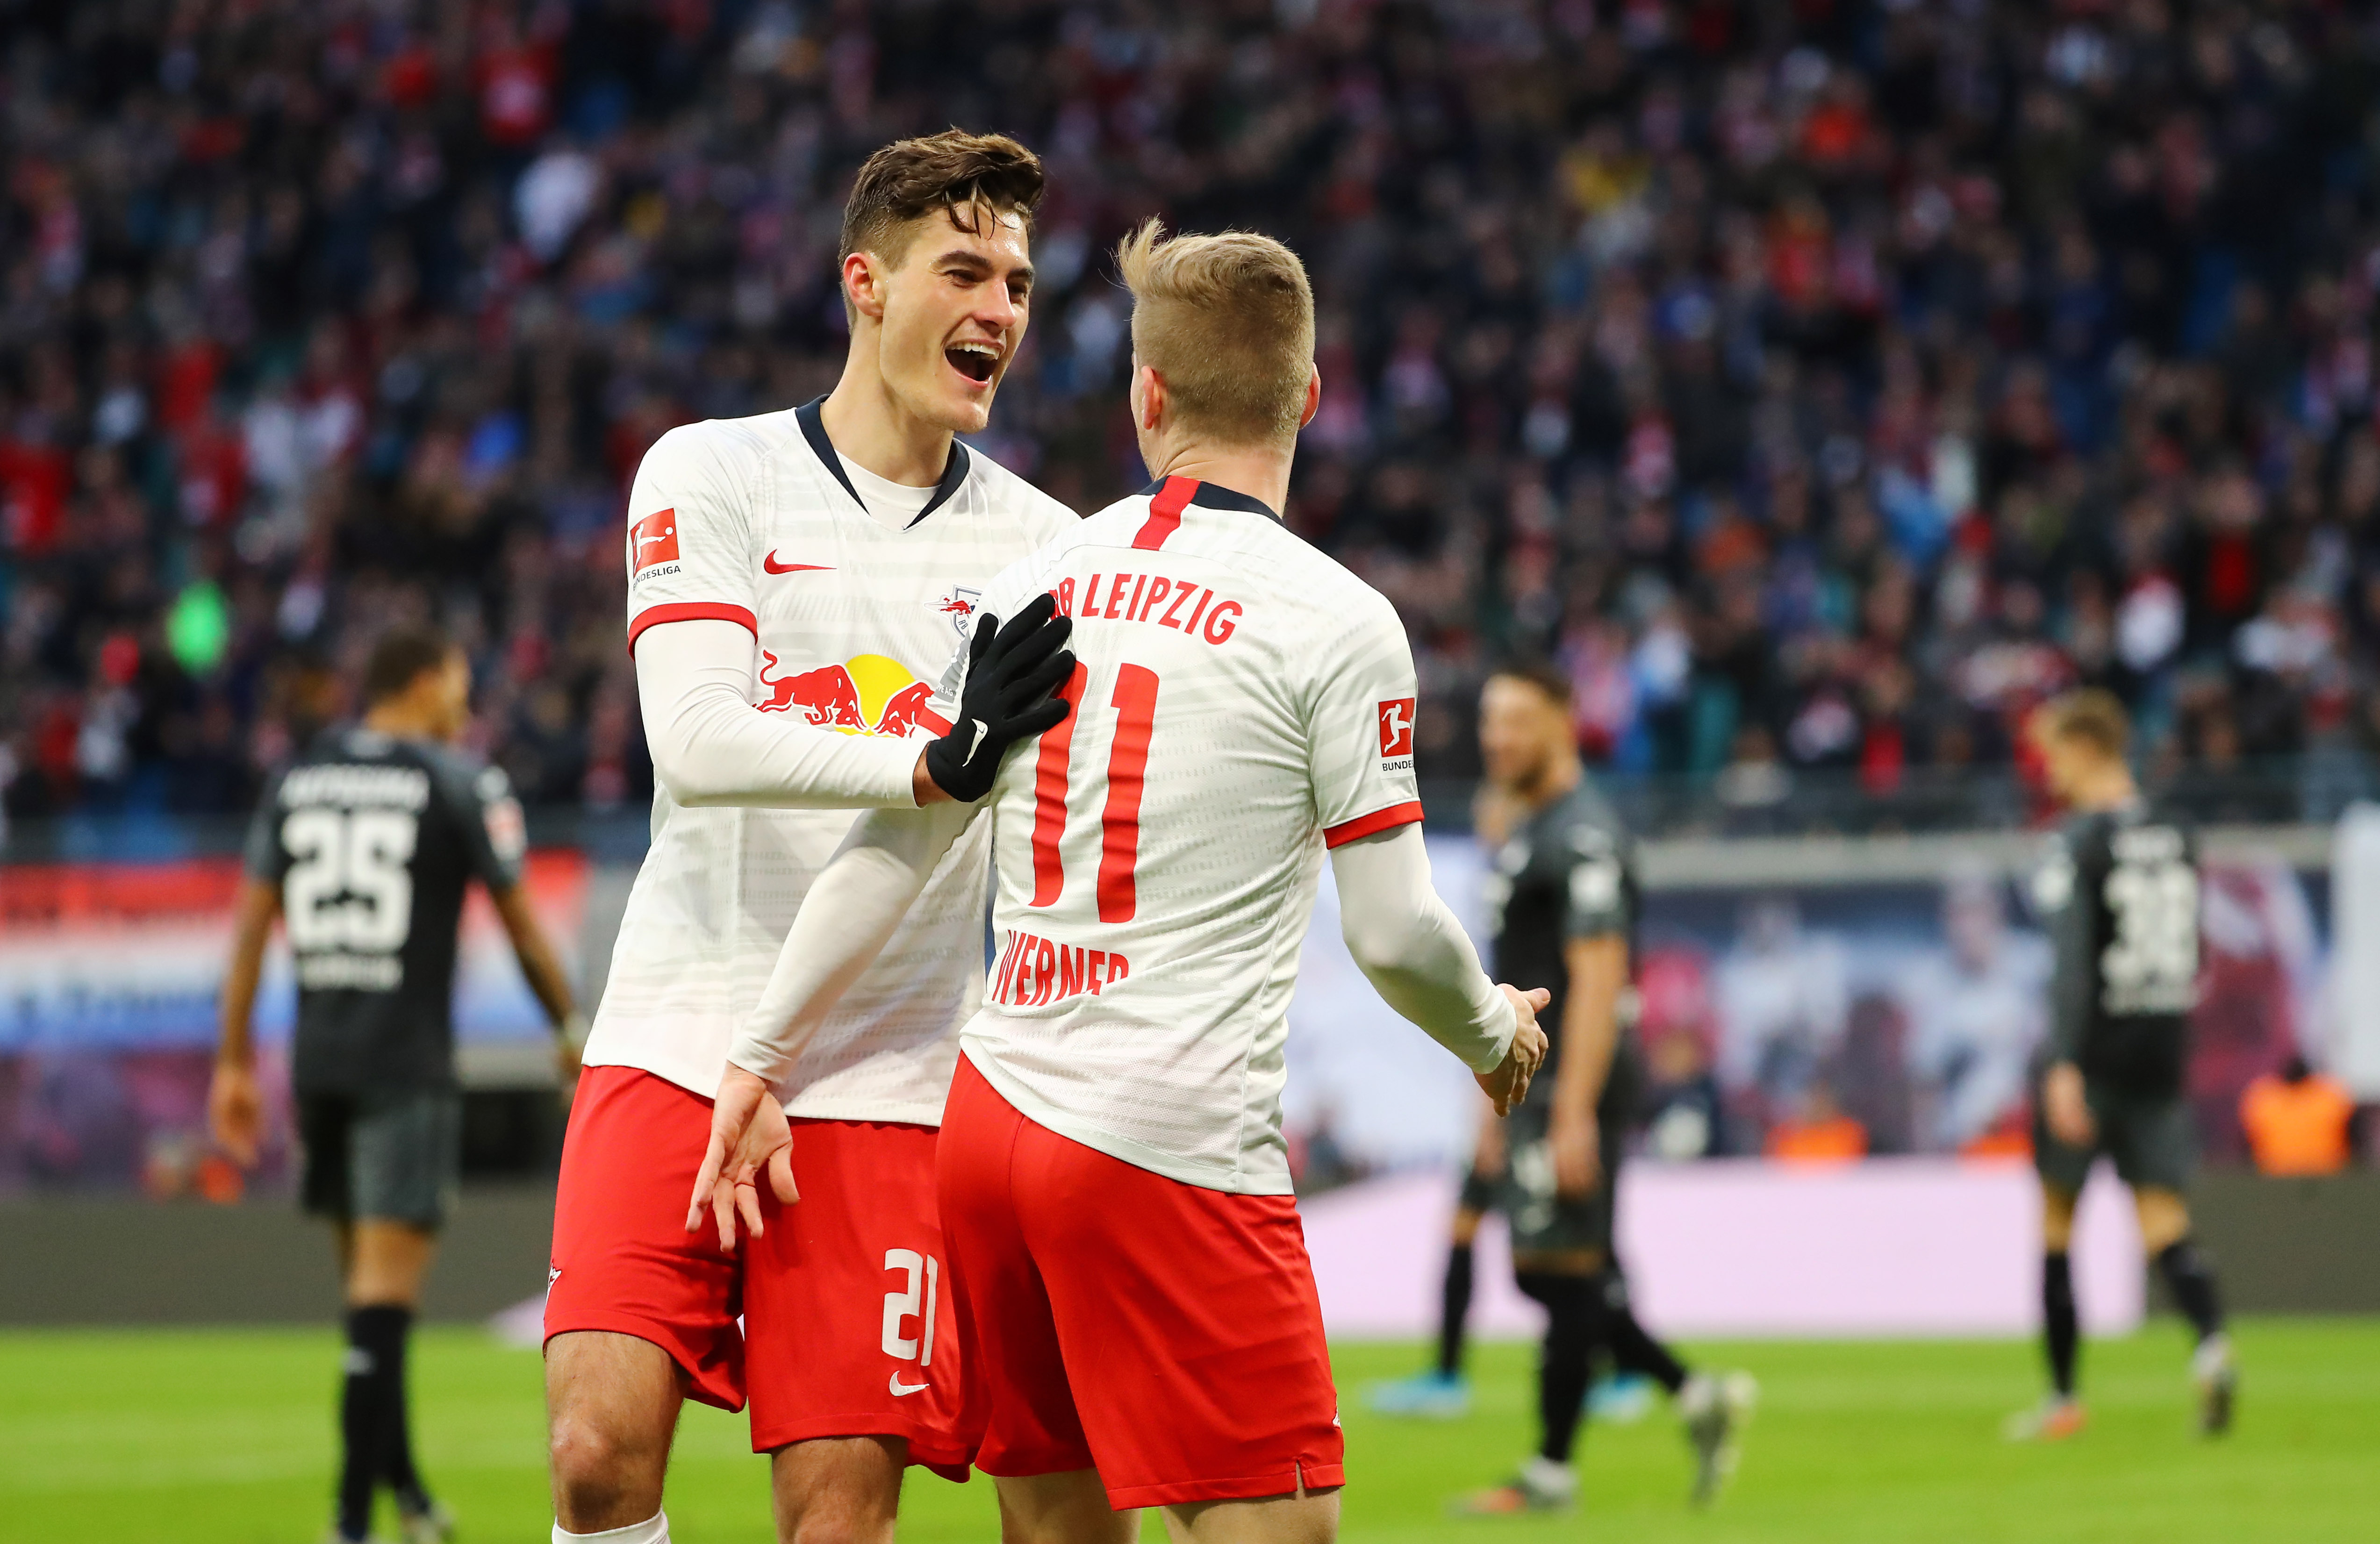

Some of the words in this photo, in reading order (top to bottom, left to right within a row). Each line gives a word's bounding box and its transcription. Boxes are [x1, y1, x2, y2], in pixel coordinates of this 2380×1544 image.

[1081, 573, 1243, 645] LEIPZIG
[1028, 660, 1160, 923] 11
[282, 810, 418, 953] 25
[991, 929, 1129, 1007] WERNER
[882, 1248, 939, 1366] 21
